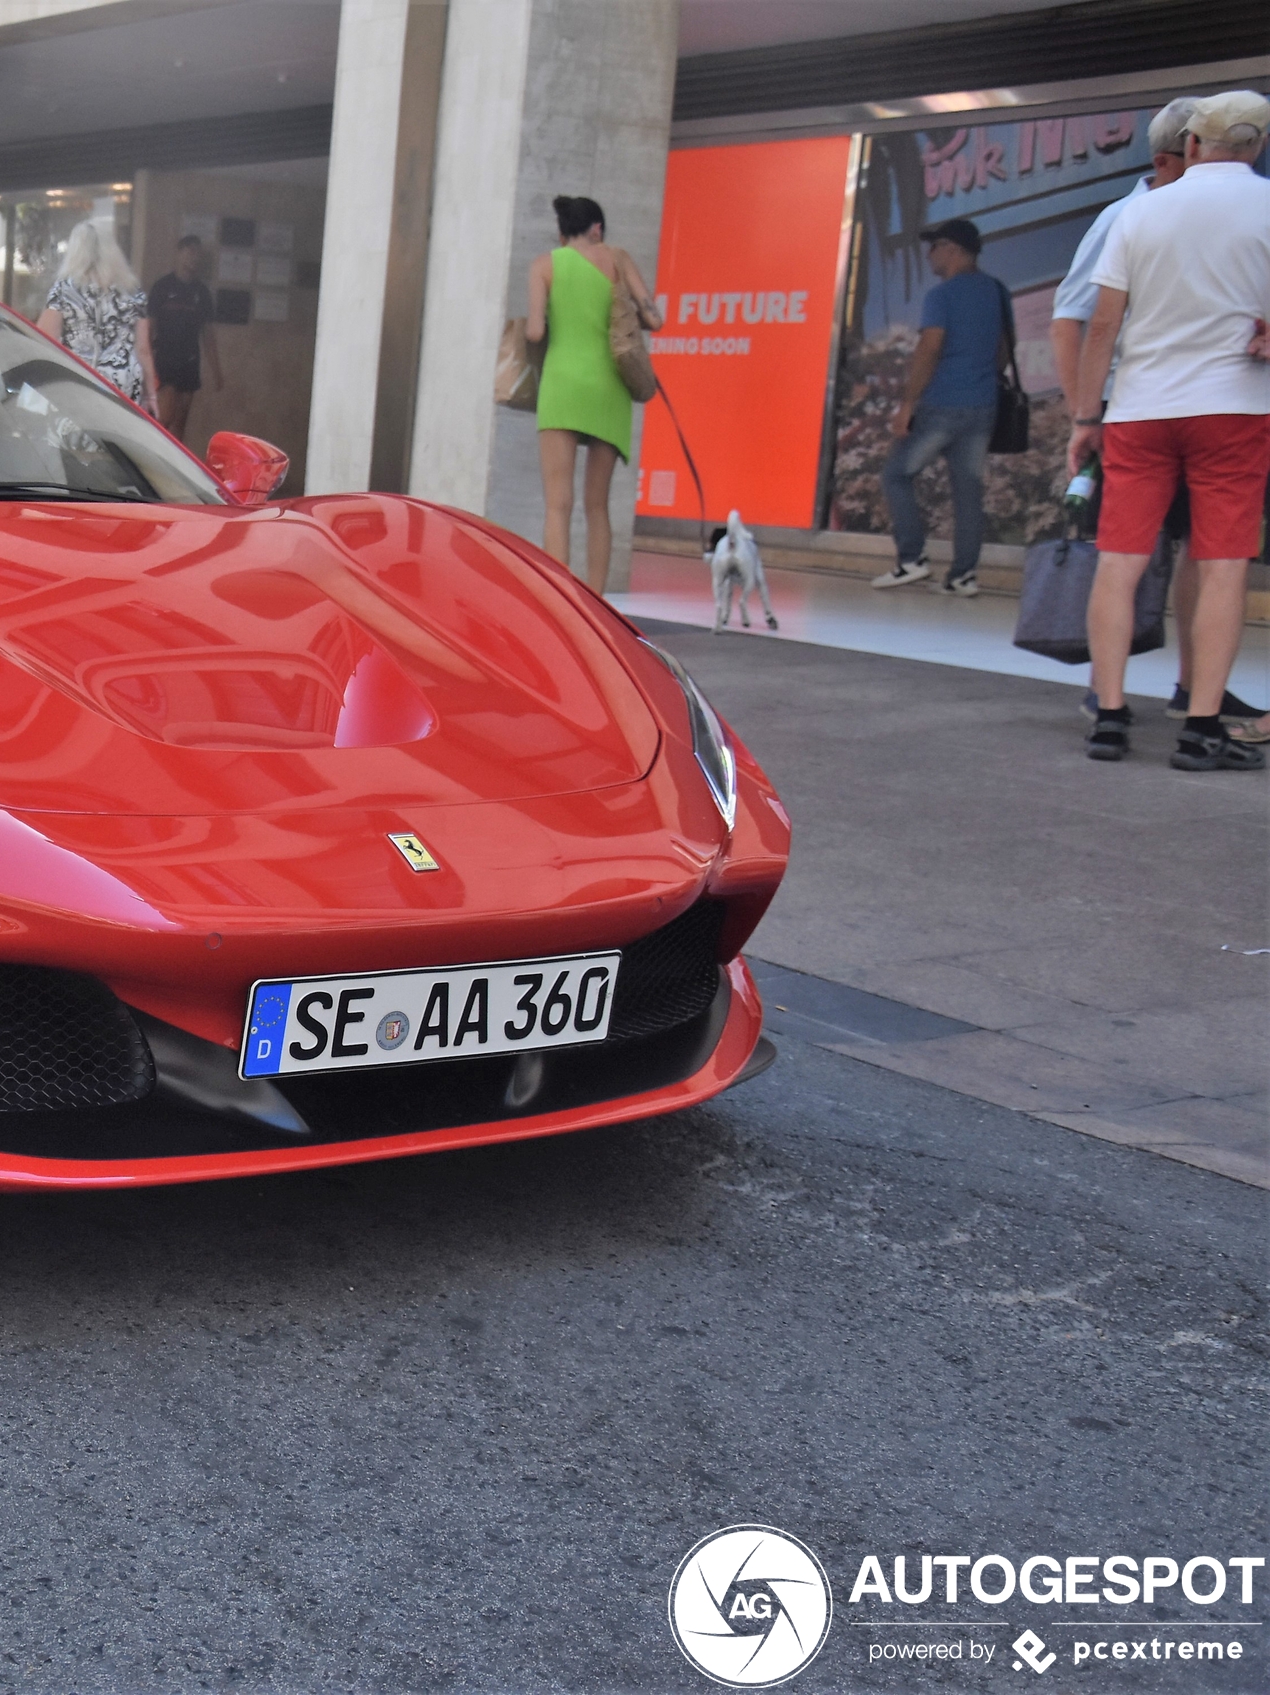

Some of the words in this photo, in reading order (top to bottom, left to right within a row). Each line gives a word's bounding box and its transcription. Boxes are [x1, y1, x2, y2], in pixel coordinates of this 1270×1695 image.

[678, 290, 808, 325] FUTURE
[700, 337, 752, 355] SOON
[289, 987, 375, 1061] SE
[414, 977, 489, 1050] AA
[503, 966, 610, 1041] 360
[256, 1039, 272, 1060] D
